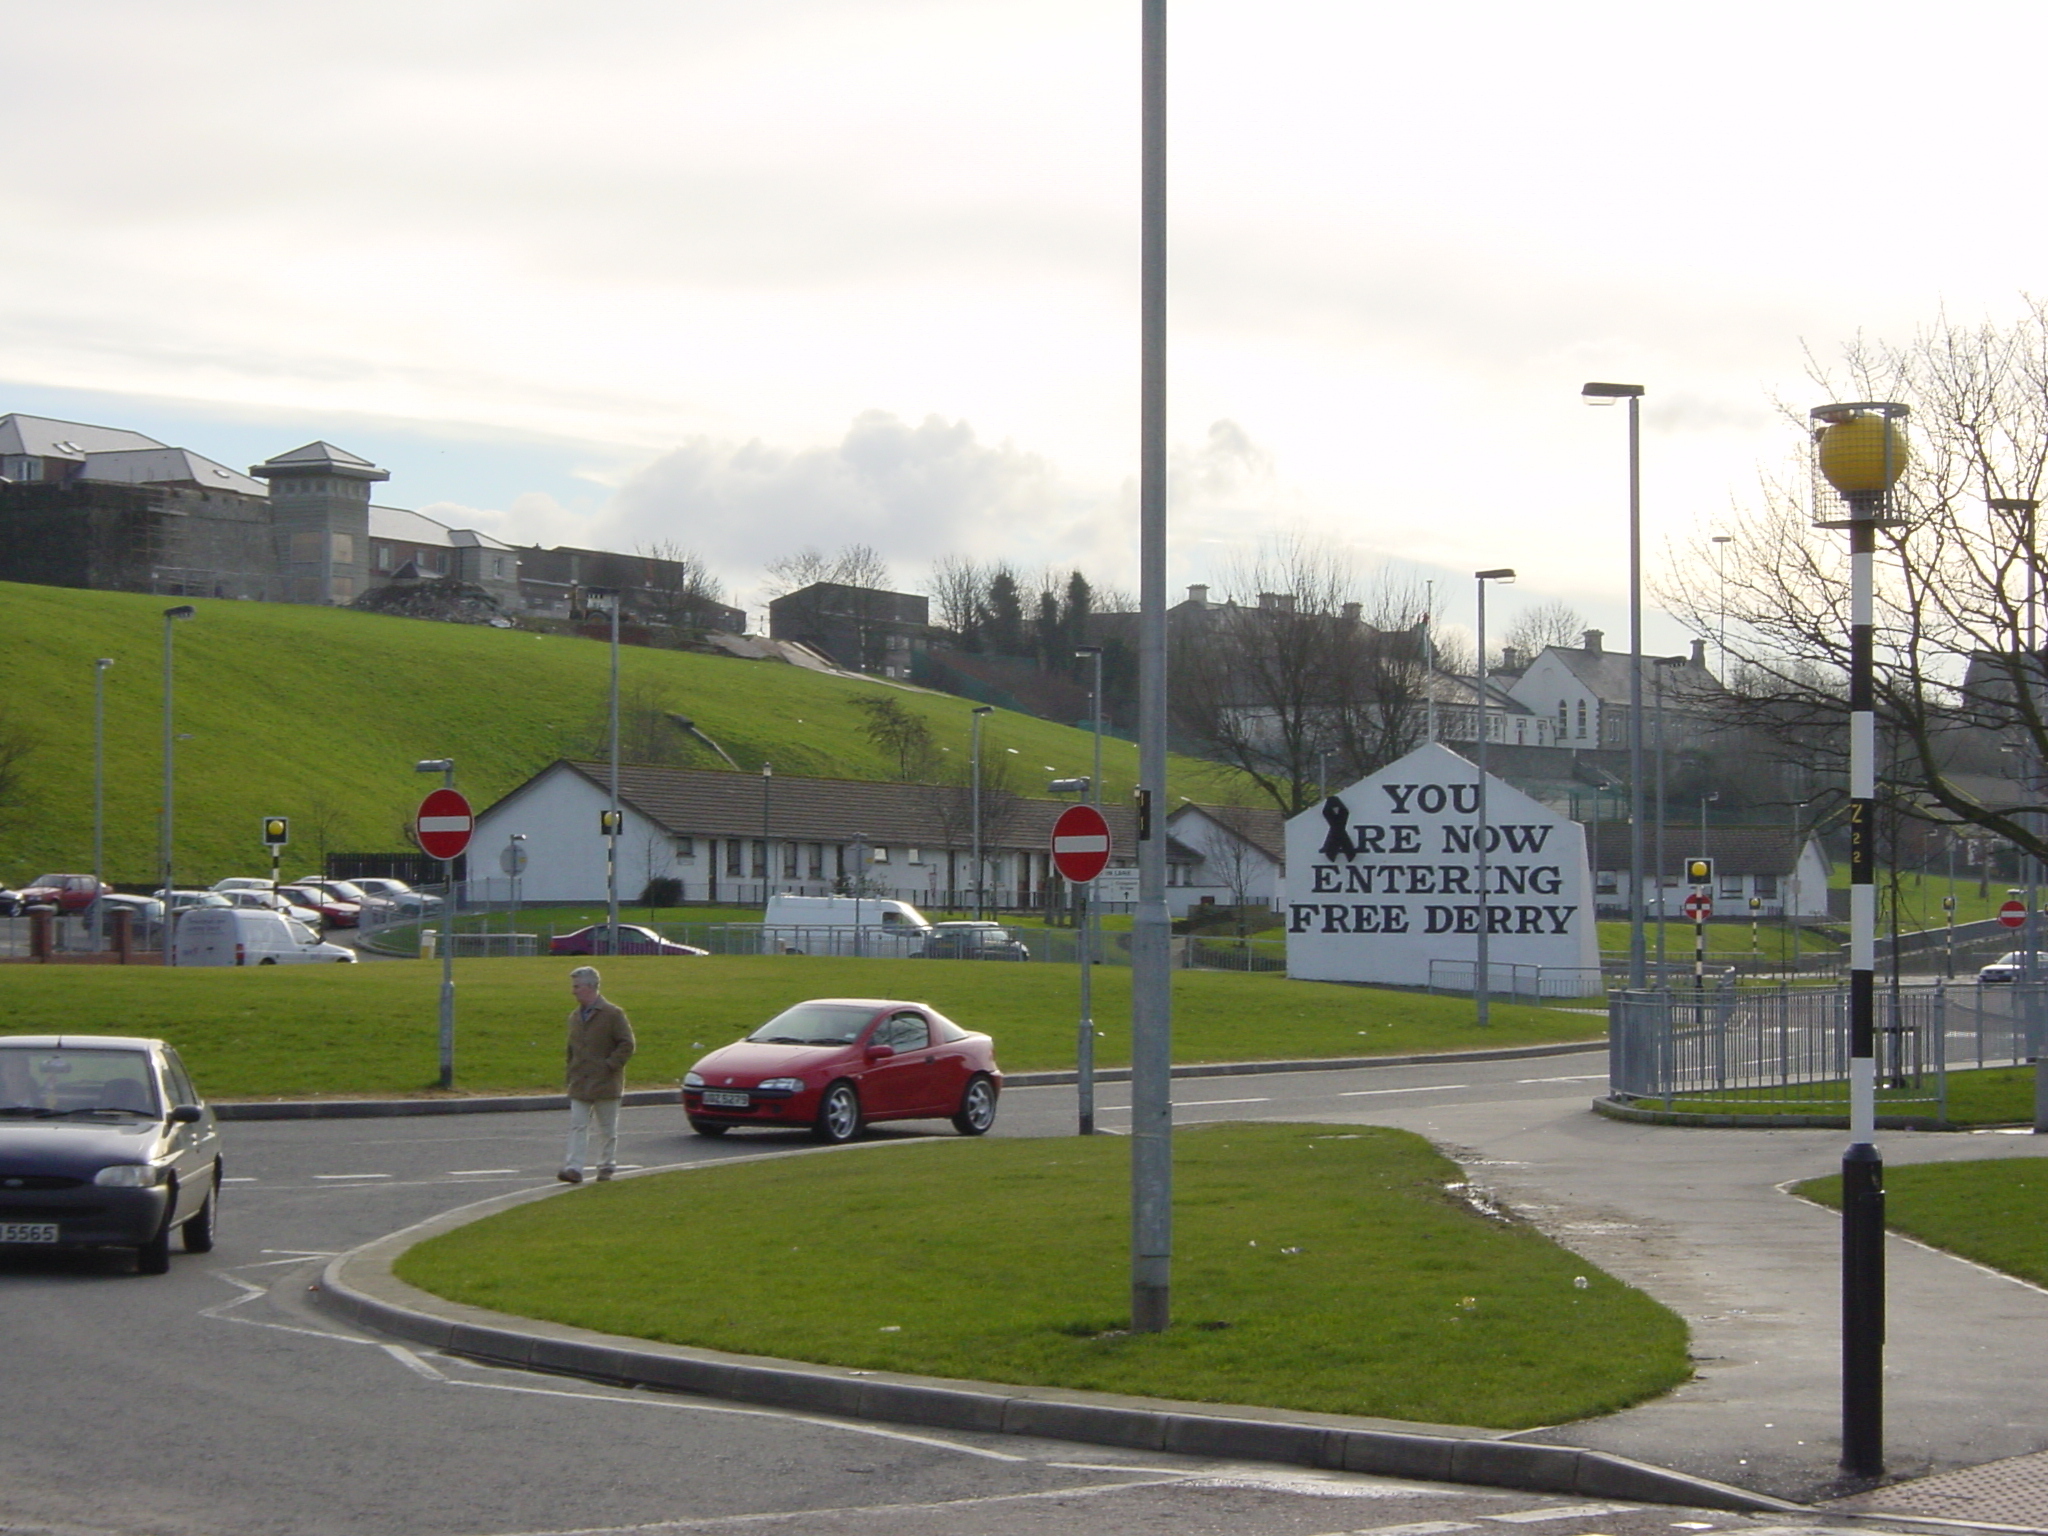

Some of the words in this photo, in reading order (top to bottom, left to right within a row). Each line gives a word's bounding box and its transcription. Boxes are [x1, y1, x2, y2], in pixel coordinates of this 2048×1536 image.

[1383, 784, 1479, 814] YOU
[1319, 825, 1422, 854] RE
[1442, 825, 1552, 854] NOW
[1288, 904, 1410, 934] FREE
[1424, 905, 1578, 935] DERRY
